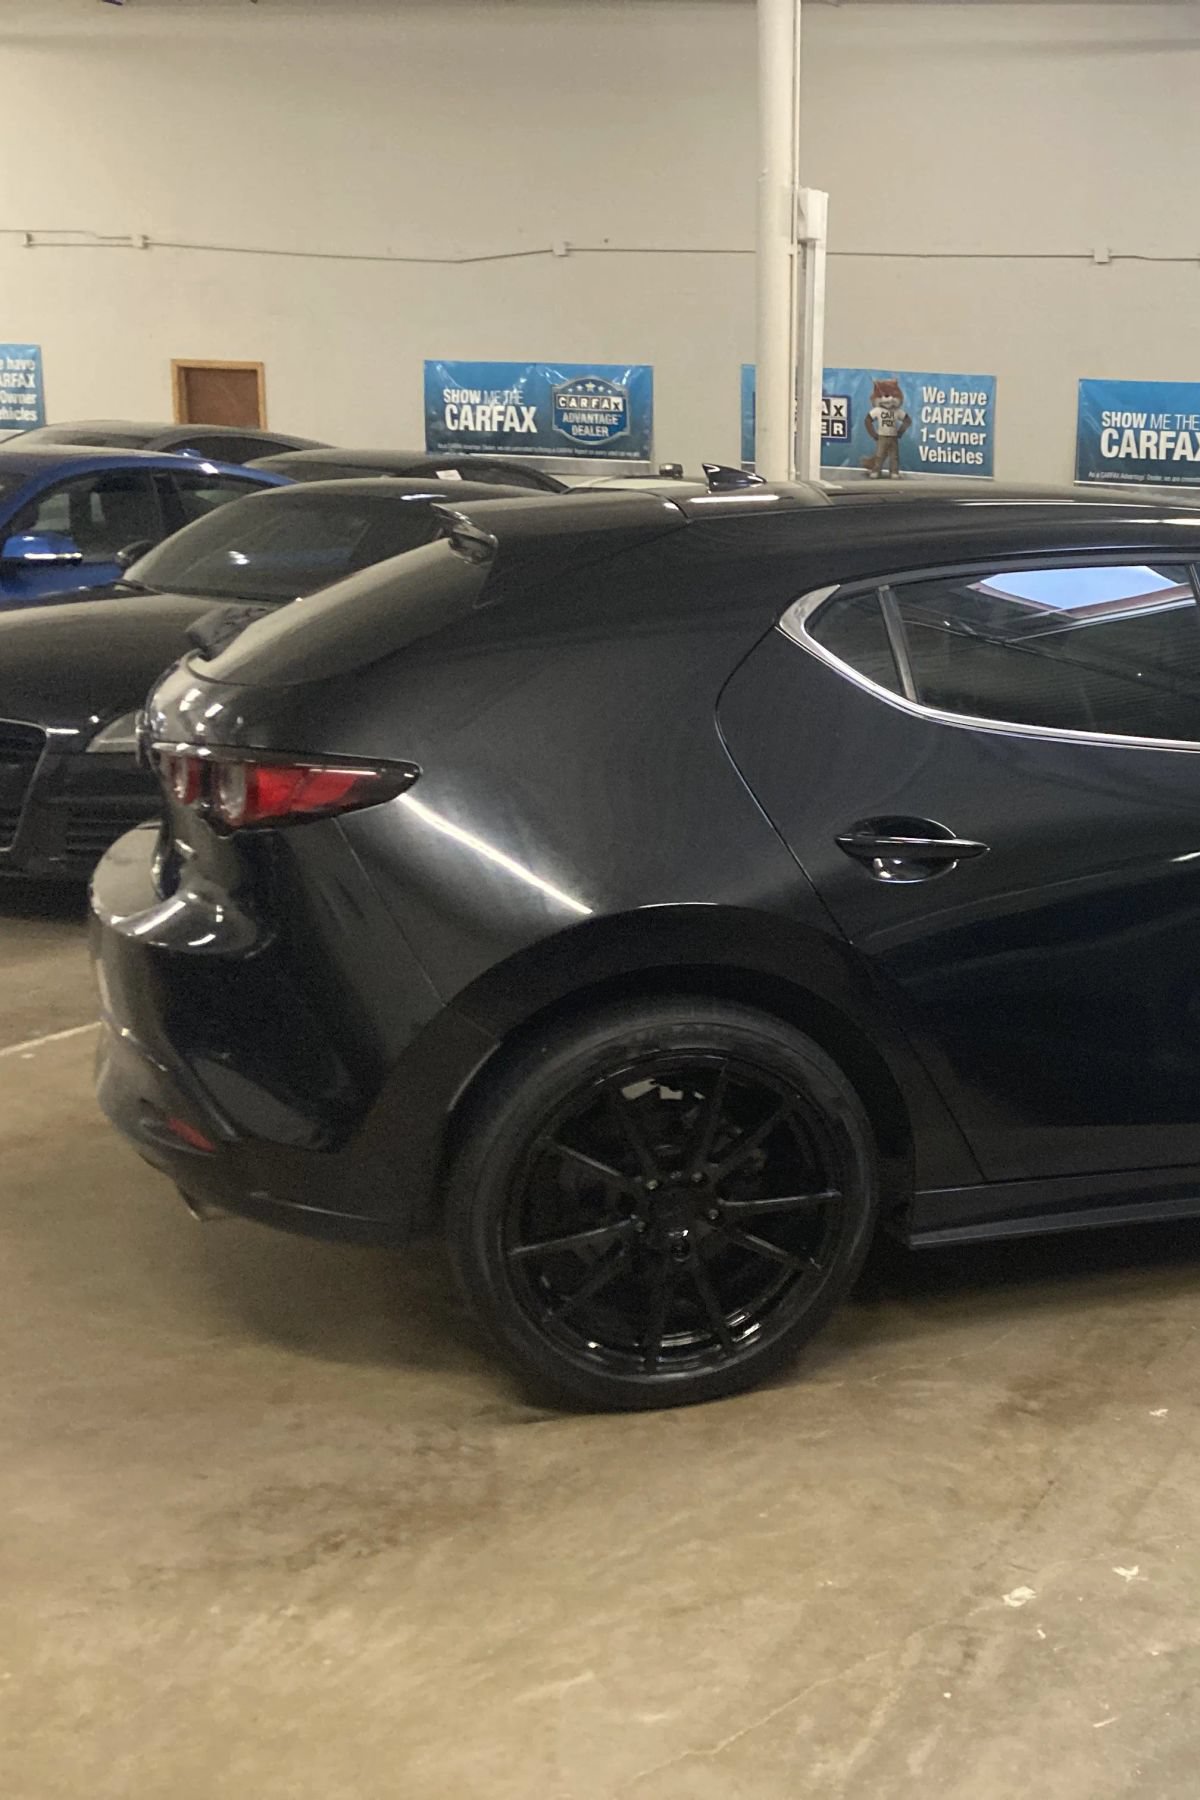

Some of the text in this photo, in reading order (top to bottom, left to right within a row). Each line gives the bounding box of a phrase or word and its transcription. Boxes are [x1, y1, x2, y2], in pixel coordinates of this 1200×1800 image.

[444, 389, 480, 403] SHOW
[558, 396, 621, 410] CARFAX
[923, 387, 987, 406] We have
[445, 405, 537, 433] CARFAX
[562, 413, 619, 425] ADVANTAGE
[921, 406, 986, 426] CARFAX
[1102, 411, 1199, 430] SHOW ME THE
[572, 424, 609, 436] DEALER
[921, 428, 986, 446] 1-Owner
[919, 447, 983, 465] Vehicles
